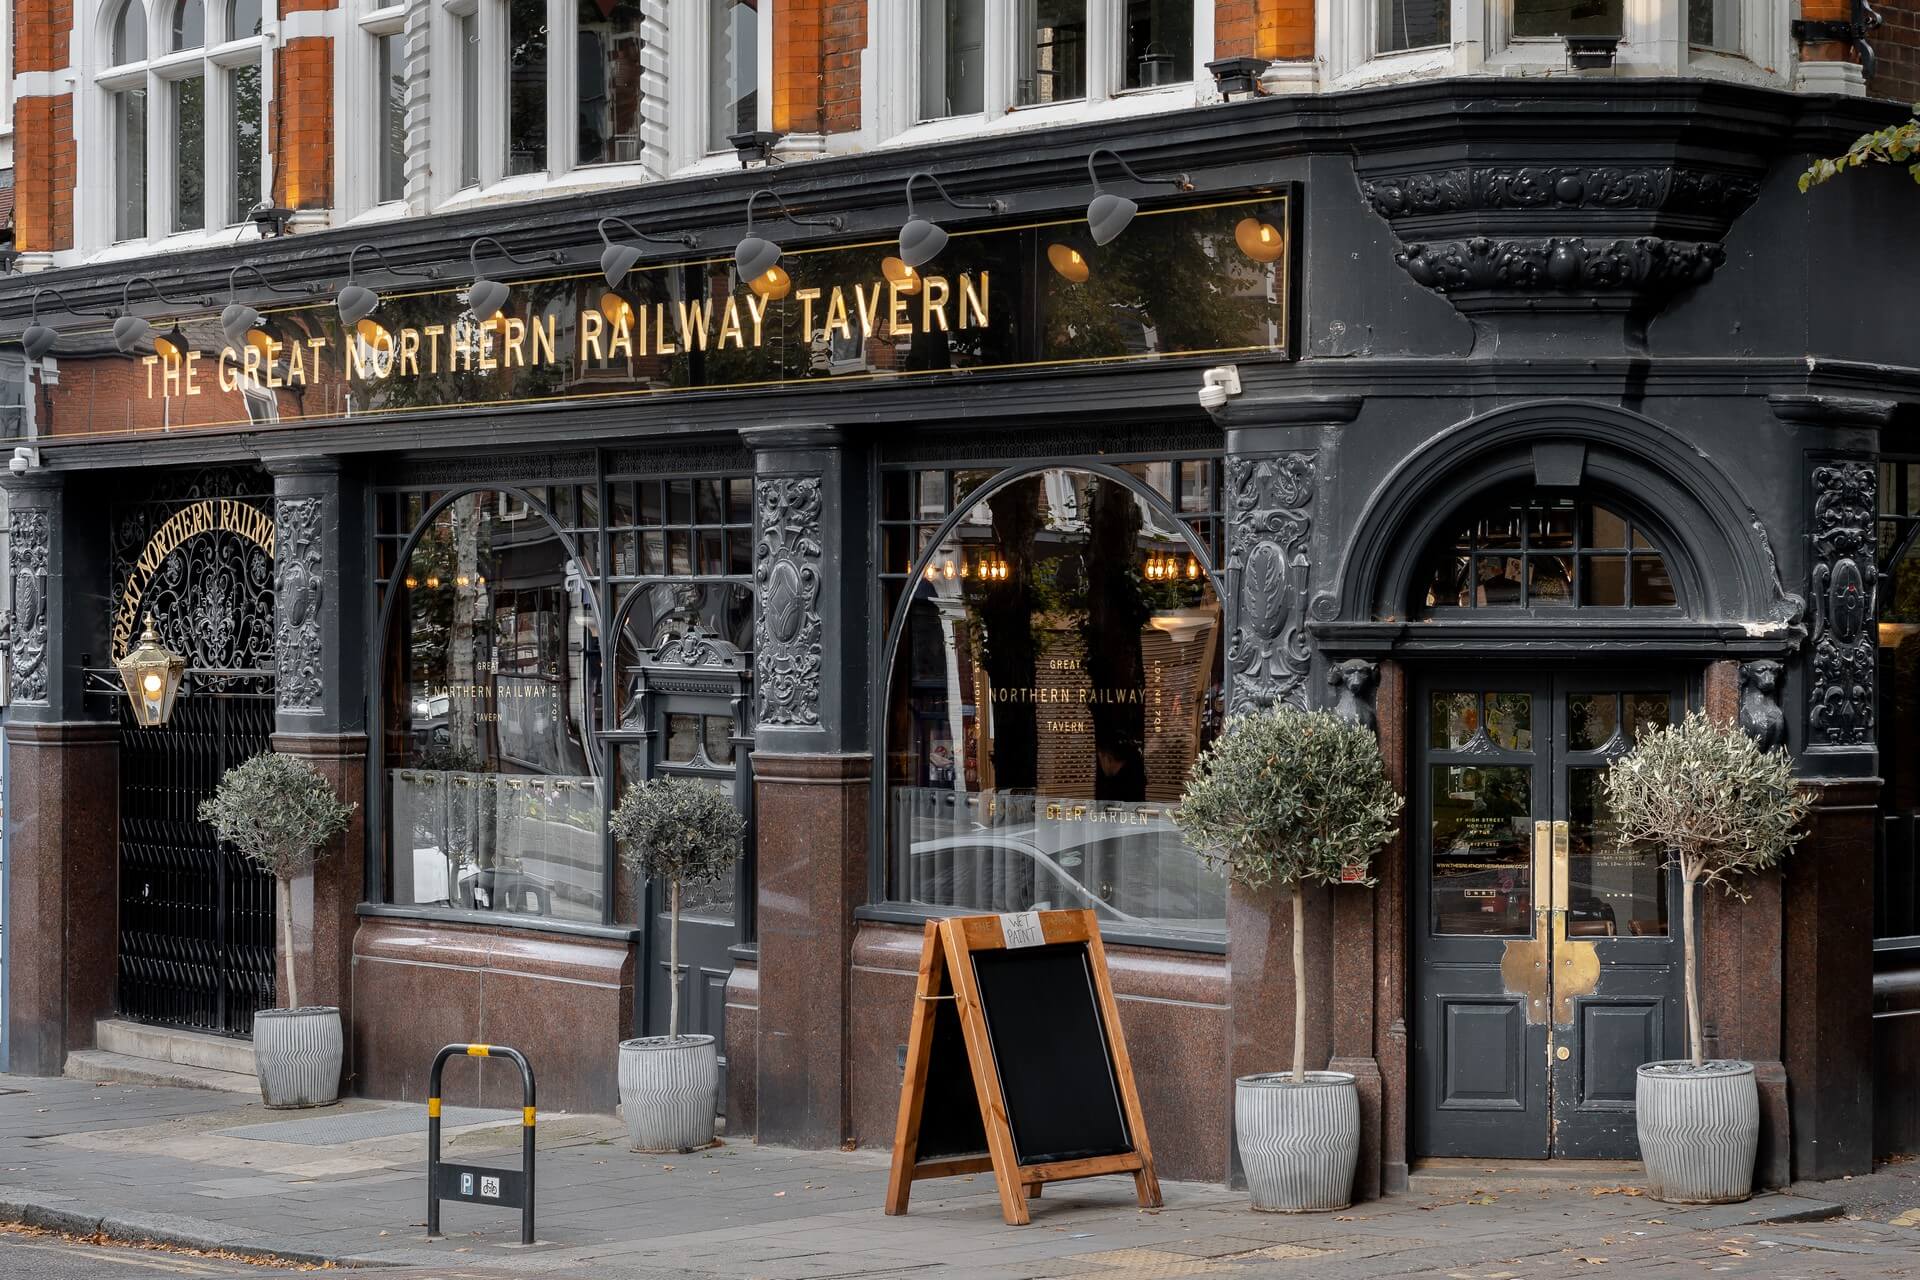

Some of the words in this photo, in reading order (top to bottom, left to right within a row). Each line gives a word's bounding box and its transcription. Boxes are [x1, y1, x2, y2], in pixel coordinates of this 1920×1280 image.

[142, 351, 201, 399] THE
[219, 337, 326, 393] GREAT
[345, 314, 555, 381] NORTHERN
[581, 292, 769, 361] RAILWAY
[796, 270, 989, 343] TAVERN
[137, 500, 213, 588] NORTHERN
[220, 500, 274, 560] RAILWA
[477, 661, 499, 671] GREAT
[974, 660, 981, 673] ST
[1050, 659, 1080, 670] GREAT
[434, 685, 492, 698] NORTHERN
[498, 685, 545, 698] RAILWAY
[990, 687, 1070, 703] NORTHERN
[1079, 687, 1146, 703] RAILWAY
[476, 712, 502, 722] TAVERN
[1047, 721, 1084, 732] TAVERN
[1046, 806, 1082, 822] BEER
[1089, 808, 1148, 825] GARDEN
[1008, 913, 1031, 928] WET
[1007, 926, 1036, 944] PAINT
[464, 1175, 472, 1192] P
